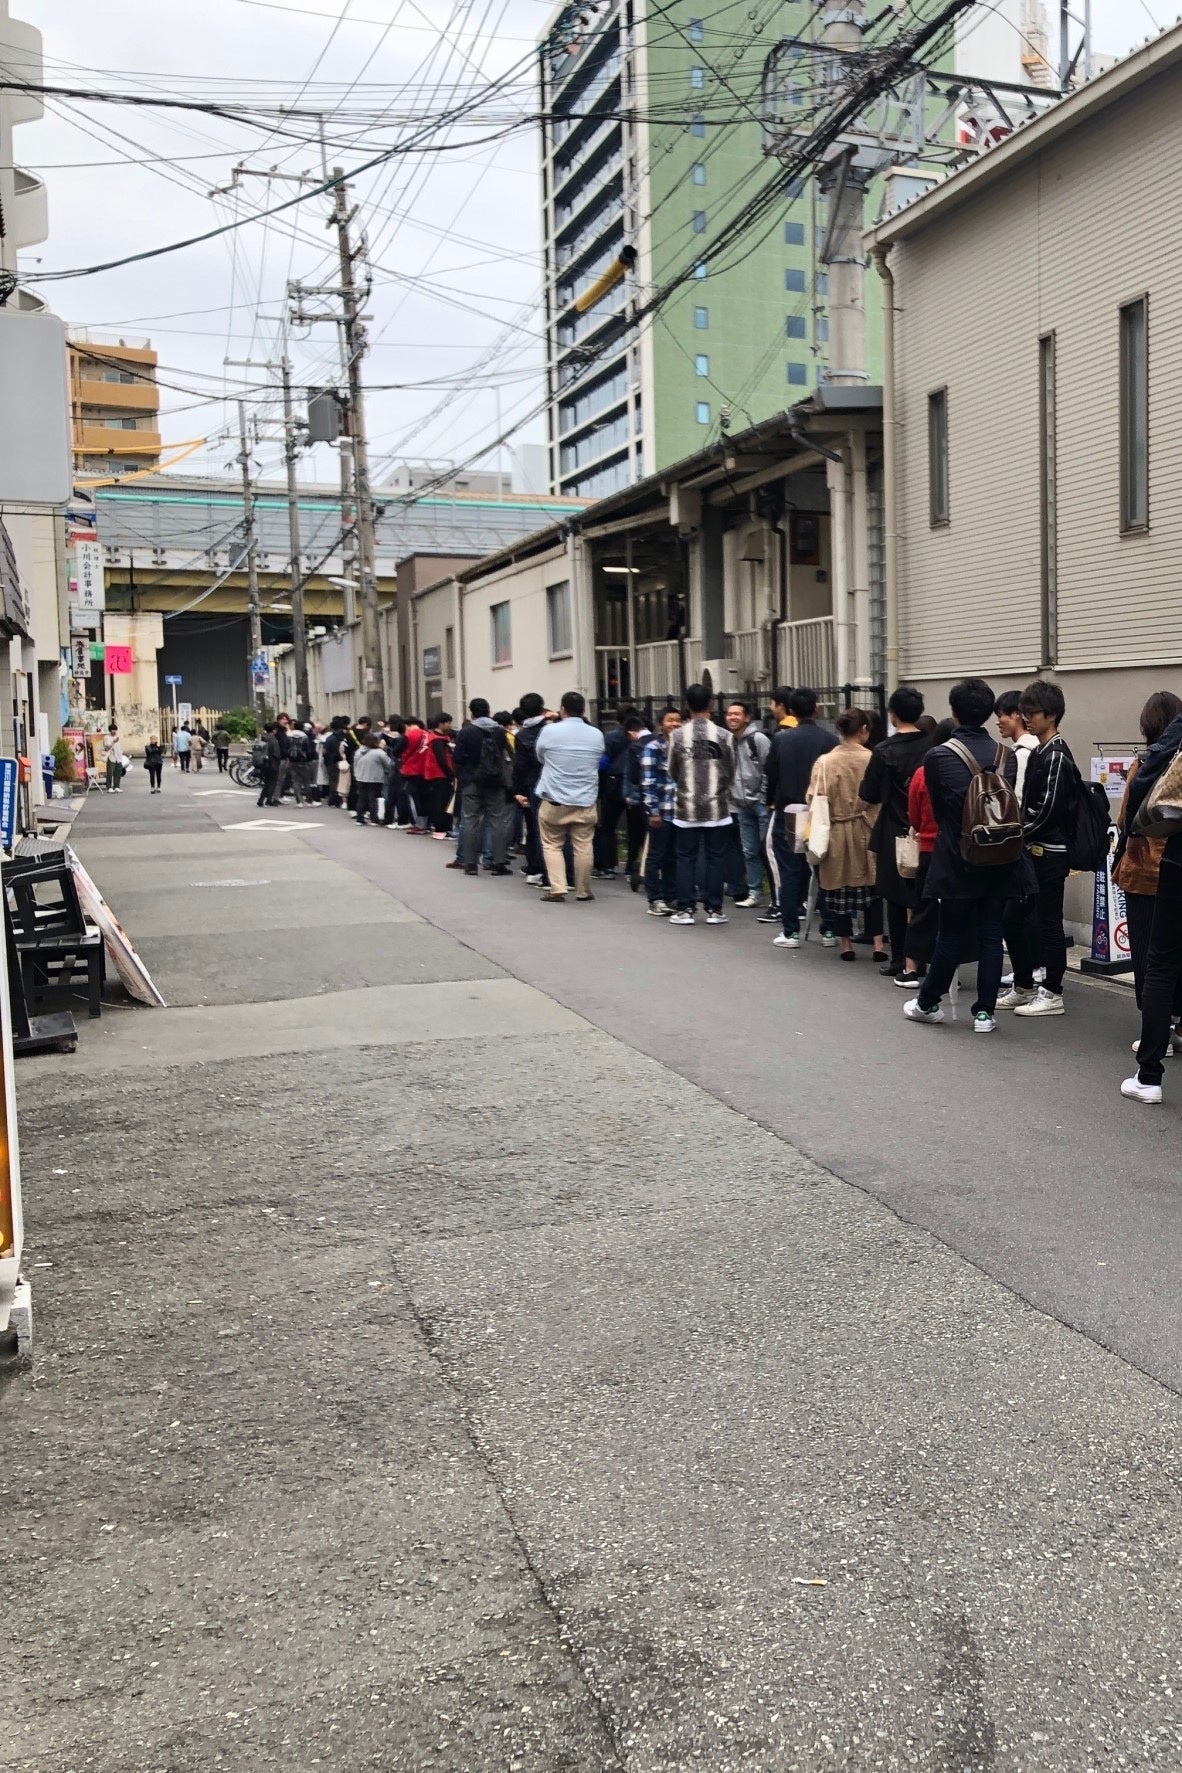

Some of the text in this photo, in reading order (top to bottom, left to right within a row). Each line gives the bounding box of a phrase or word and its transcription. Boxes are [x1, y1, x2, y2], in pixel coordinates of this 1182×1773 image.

[81, 544, 93, 607] 小川会計事務所
[1116, 885, 1127, 919] KING
